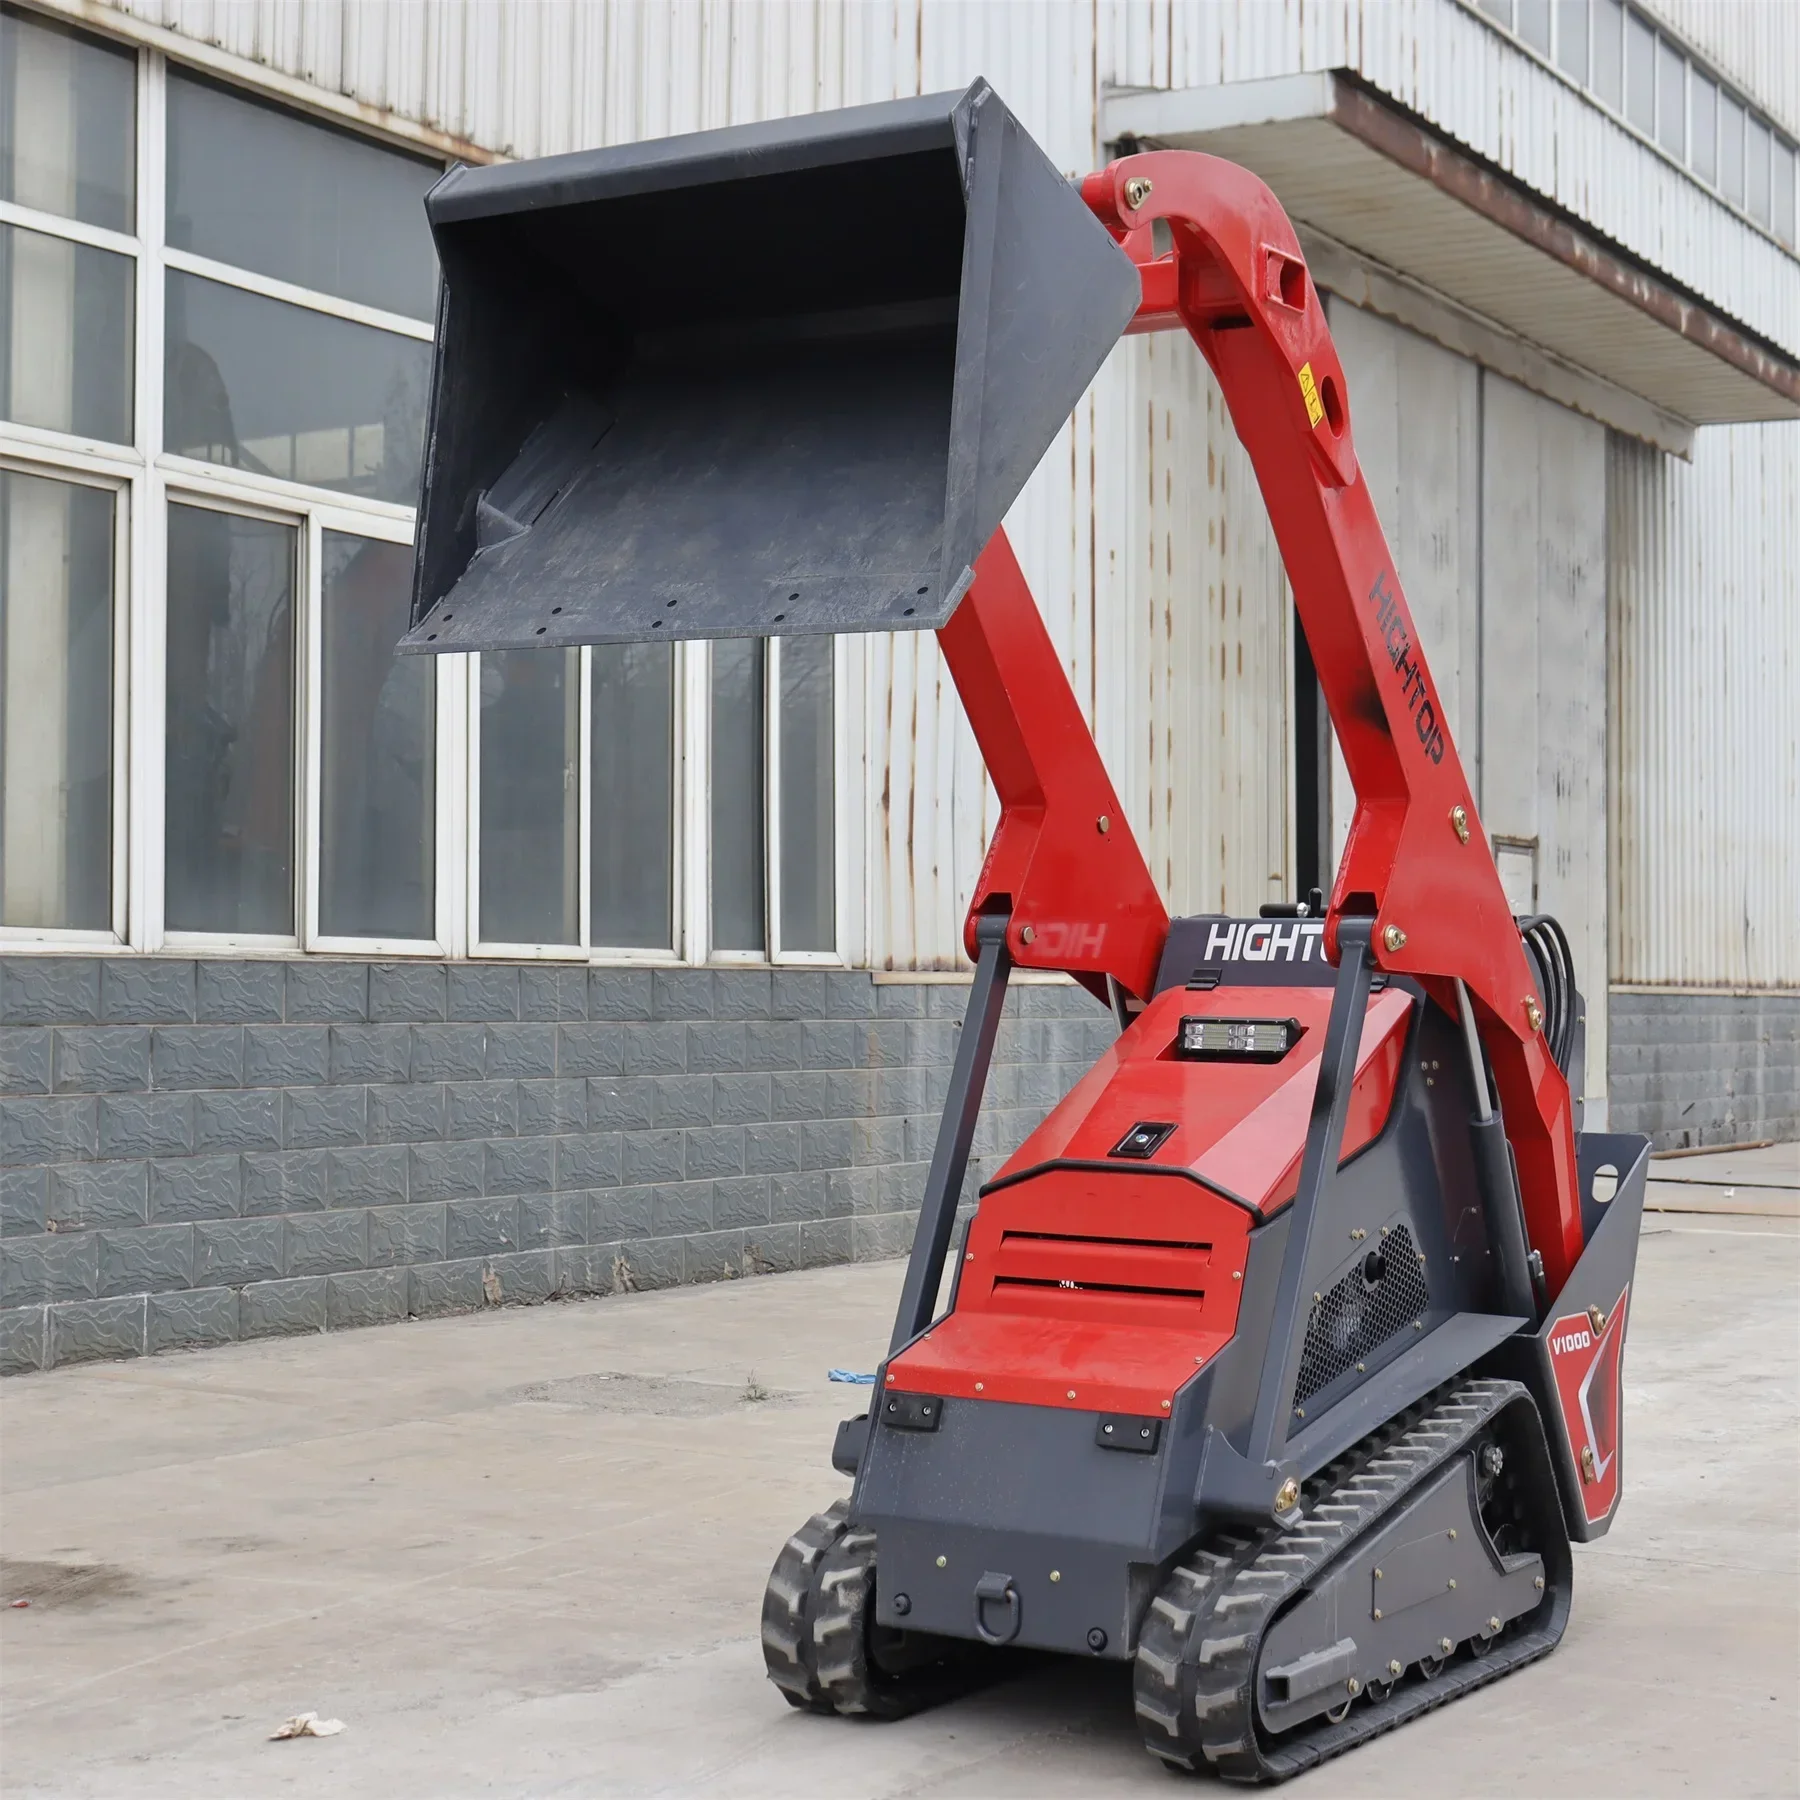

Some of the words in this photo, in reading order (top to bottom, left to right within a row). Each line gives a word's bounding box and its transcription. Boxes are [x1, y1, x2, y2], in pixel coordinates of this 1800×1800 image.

[1369, 571, 1444, 765] HIGHTOP
[1203, 923, 1328, 962] HIGHT
[1552, 1331, 1591, 1355] V1000
